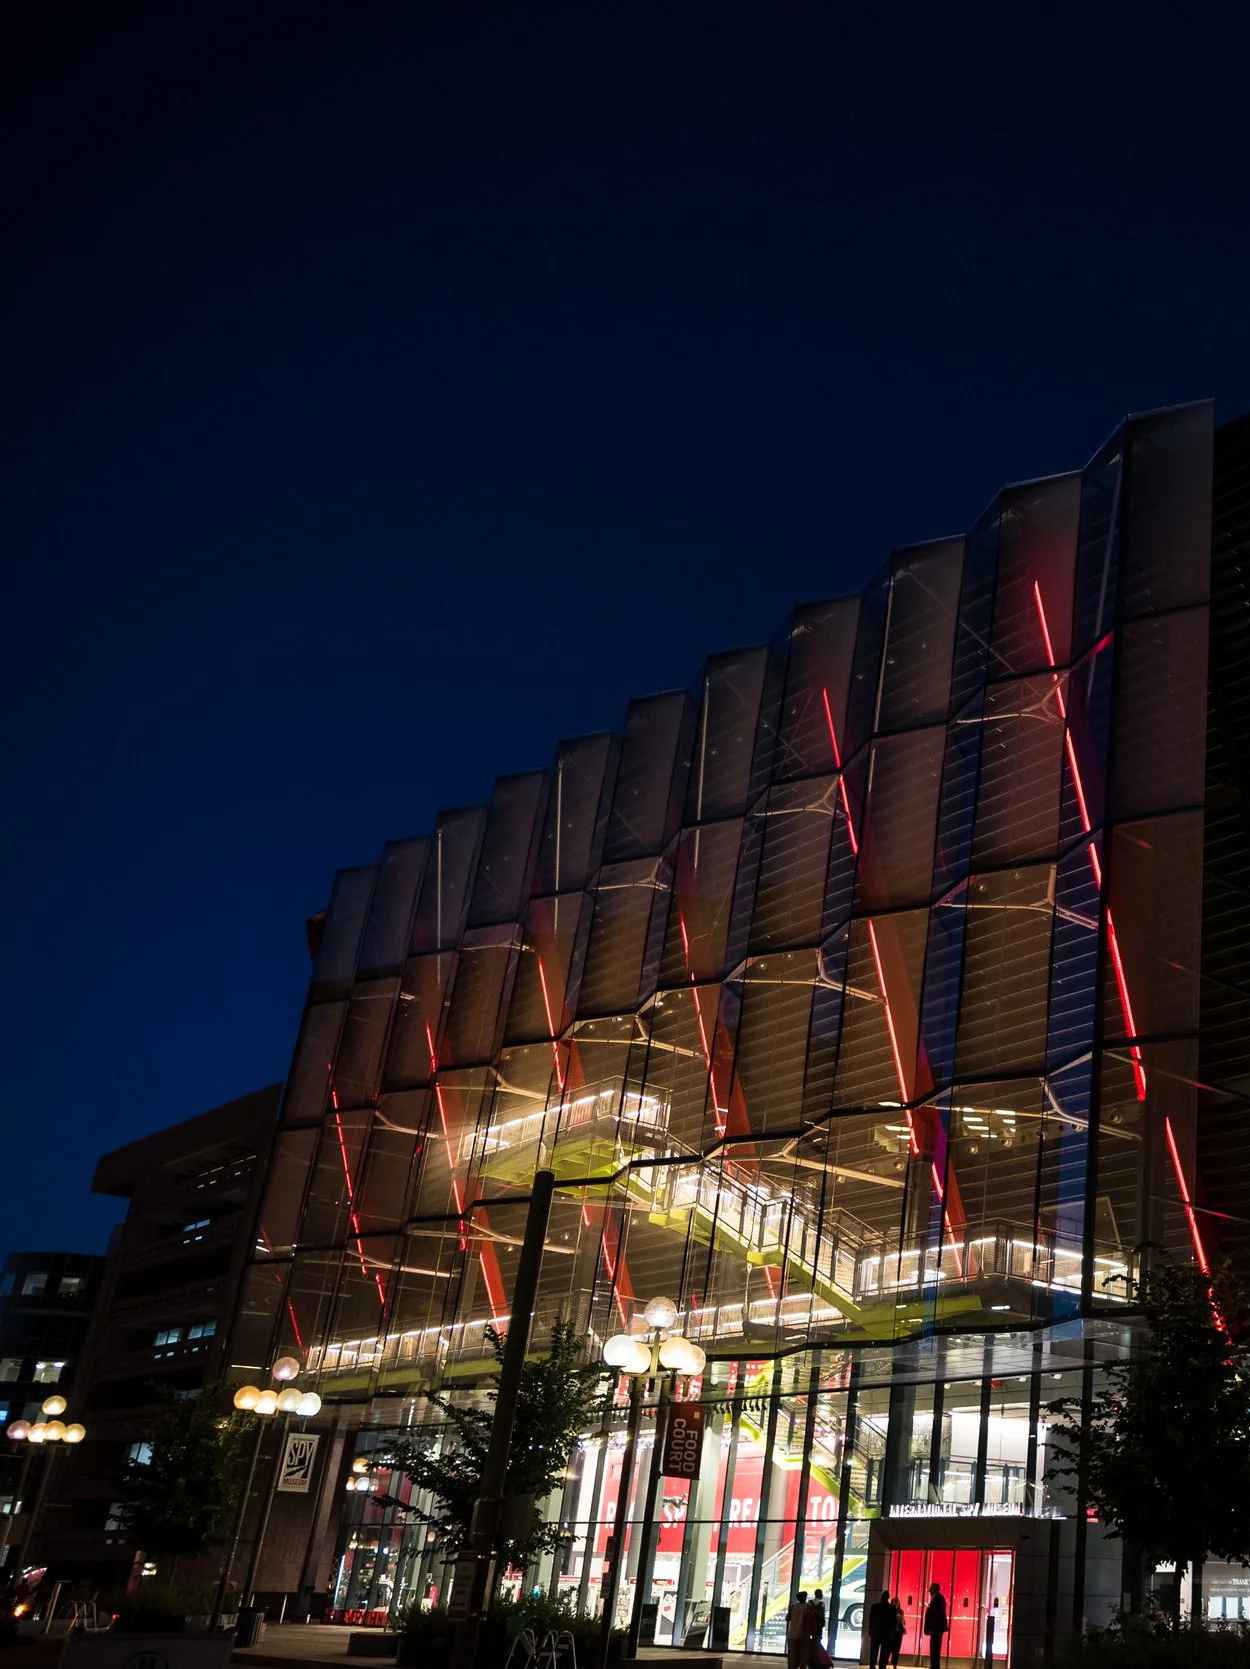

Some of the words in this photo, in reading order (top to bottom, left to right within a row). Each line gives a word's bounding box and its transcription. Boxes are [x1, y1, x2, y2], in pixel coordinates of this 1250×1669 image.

[287, 1440, 315, 1466] SPY
[668, 1418, 687, 1472] COURT
[682, 1429, 699, 1473] FOOD
[959, 1502, 980, 1517] SPY
[981, 1502, 1022, 1517] MUSEUM
